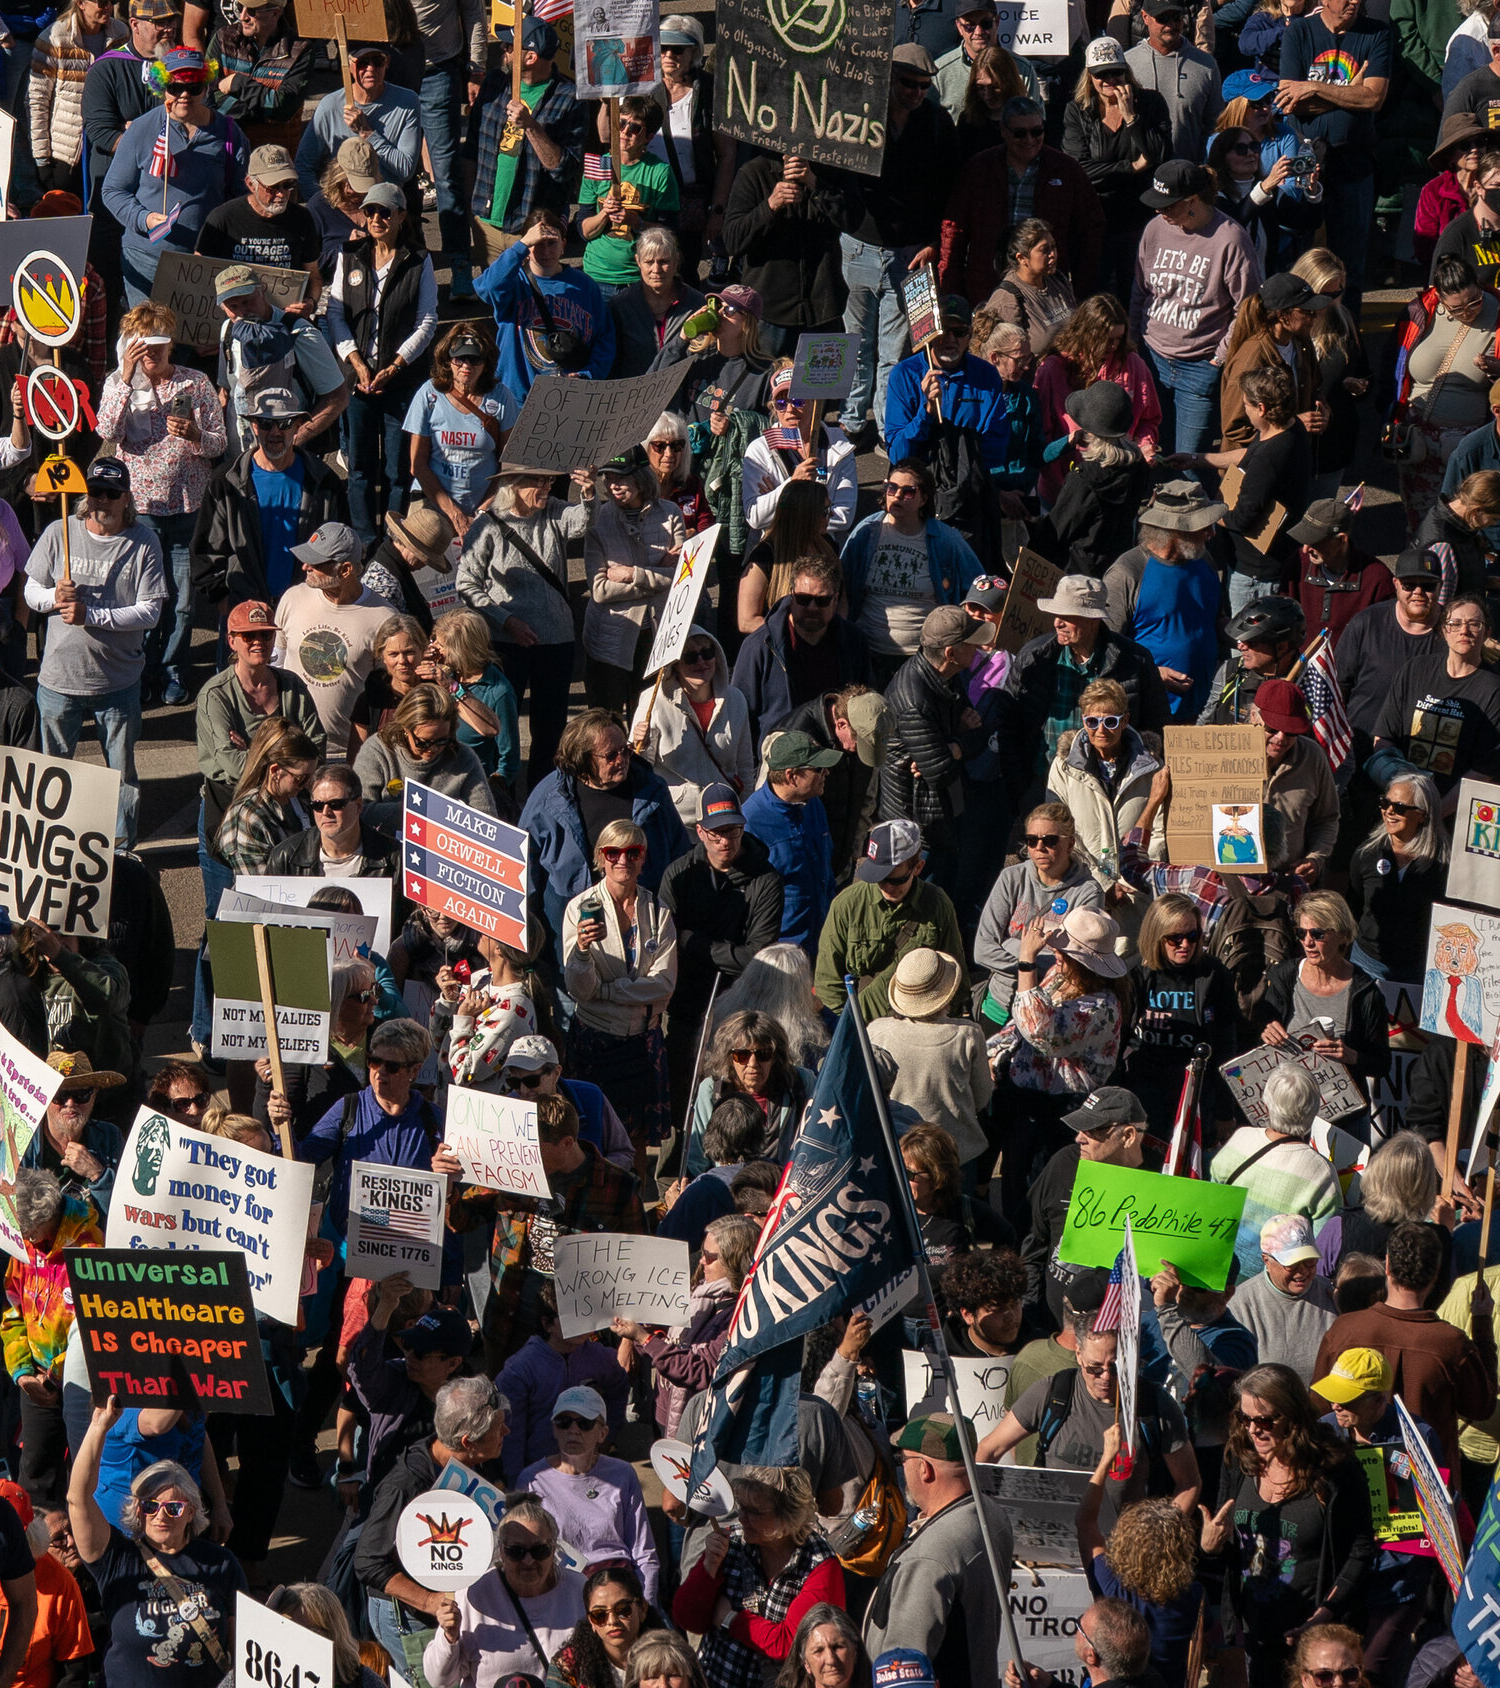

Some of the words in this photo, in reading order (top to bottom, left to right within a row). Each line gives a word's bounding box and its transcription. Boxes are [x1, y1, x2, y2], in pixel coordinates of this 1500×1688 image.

[848, 6, 860, 17] No
[863, 3, 891, 21] Bigots
[1014, 10, 1039, 21] ICE
[845, 25, 857, 36] No
[863, 25, 888, 37] Liars
[1016, 33, 1053, 44] WAR
[718, 24, 730, 38] No
[734, 29, 786, 69] Oligarchy
[835, 39, 846, 51] No
[852, 43, 889, 60] Crooks
[827, 58, 840, 73] No
[844, 61, 874, 85] Idiots
[727, 56, 777, 132] No
[791, 71, 884, 148] Nazis
[234, 244, 290, 255] OUTRAGED
[178, 262, 200, 284] NO
[441, 430, 476, 447] NASTY
[661, 584, 690, 631] NO
[1425, 694, 1444, 706] Same
[0, 755, 73, 820] NO
[444, 804, 498, 842] MAKE
[436, 833, 506, 878] ORWELL
[261, 884, 297, 904] The
[436, 861, 507, 907] FICTION
[443, 896, 498, 932] AGAIN
[222, 1008, 246, 1022] NOT
[249, 1009, 266, 1023] MY
[221, 1033, 245, 1048] NOT
[247, 1035, 267, 1049] MY
[279, 1037, 320, 1053] ELIEFS
[361, 1174, 433, 1197] RESISTING
[369, 1190, 424, 1212] KINGS
[358, 1241, 397, 1258] SINCE
[400, 1245, 430, 1262] 1776
[558, 1267, 635, 1296] WRONG
[647, 1269, 686, 1287] ICE
[98, 1371, 179, 1396] Than
[190, 1373, 249, 1399] War
[431, 1545, 463, 1562] NO
[431, 1562, 463, 1571] KINGS
[876, 1670, 897, 1684] Boise
[898, 1667, 924, 1680] State
